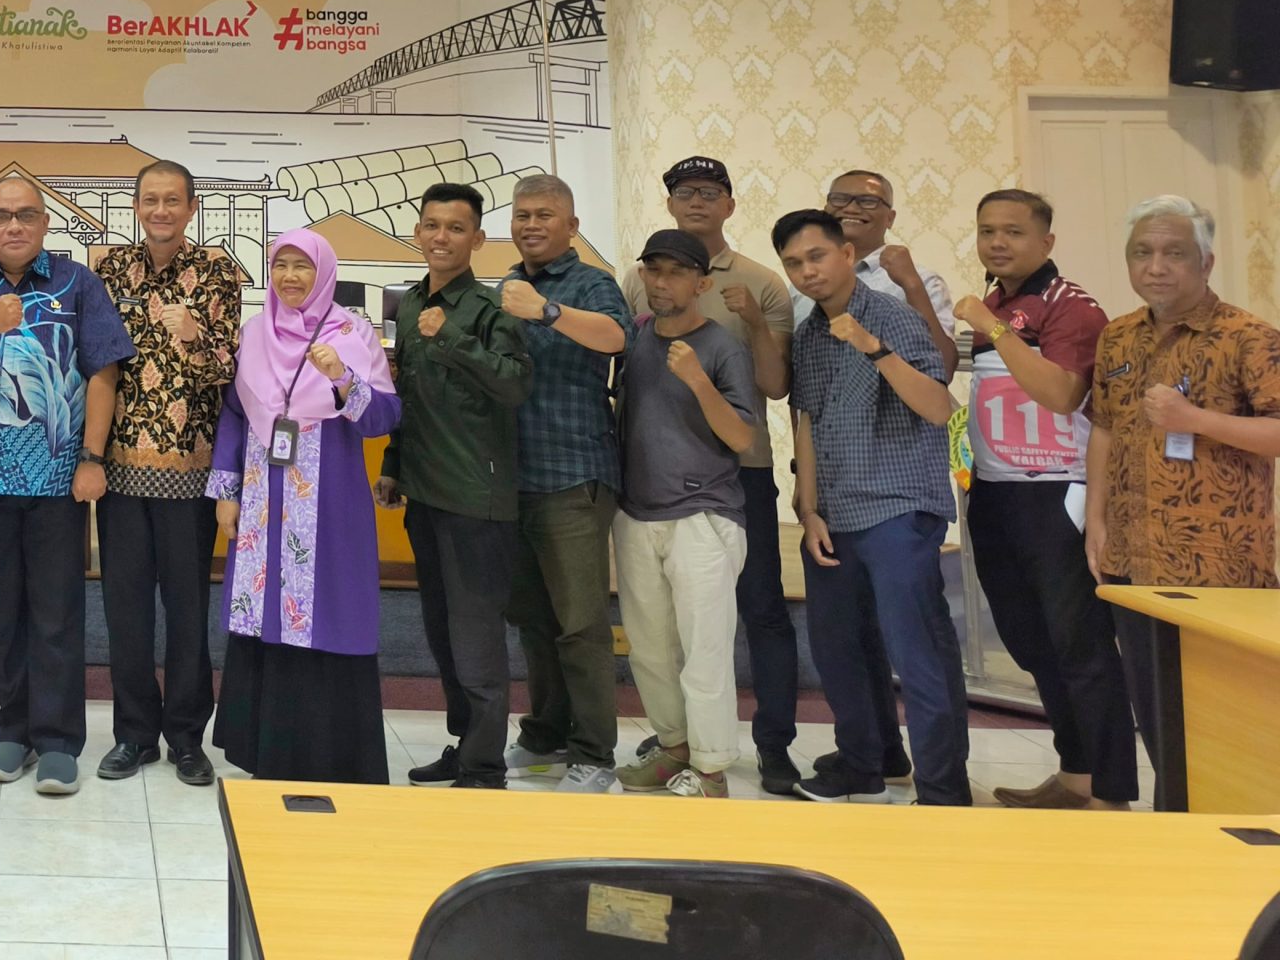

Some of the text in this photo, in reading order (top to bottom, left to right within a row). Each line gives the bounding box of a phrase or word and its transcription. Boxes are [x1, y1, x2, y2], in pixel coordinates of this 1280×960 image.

[306, 8, 369, 25] bangga
[107, 15, 250, 37] BerAKHLAK
[306, 23, 380, 39] melayani
[1, 41, 63, 50] Khatulistiwa
[306, 38, 367, 55] bangsa
[984, 395, 1079, 449] 119
